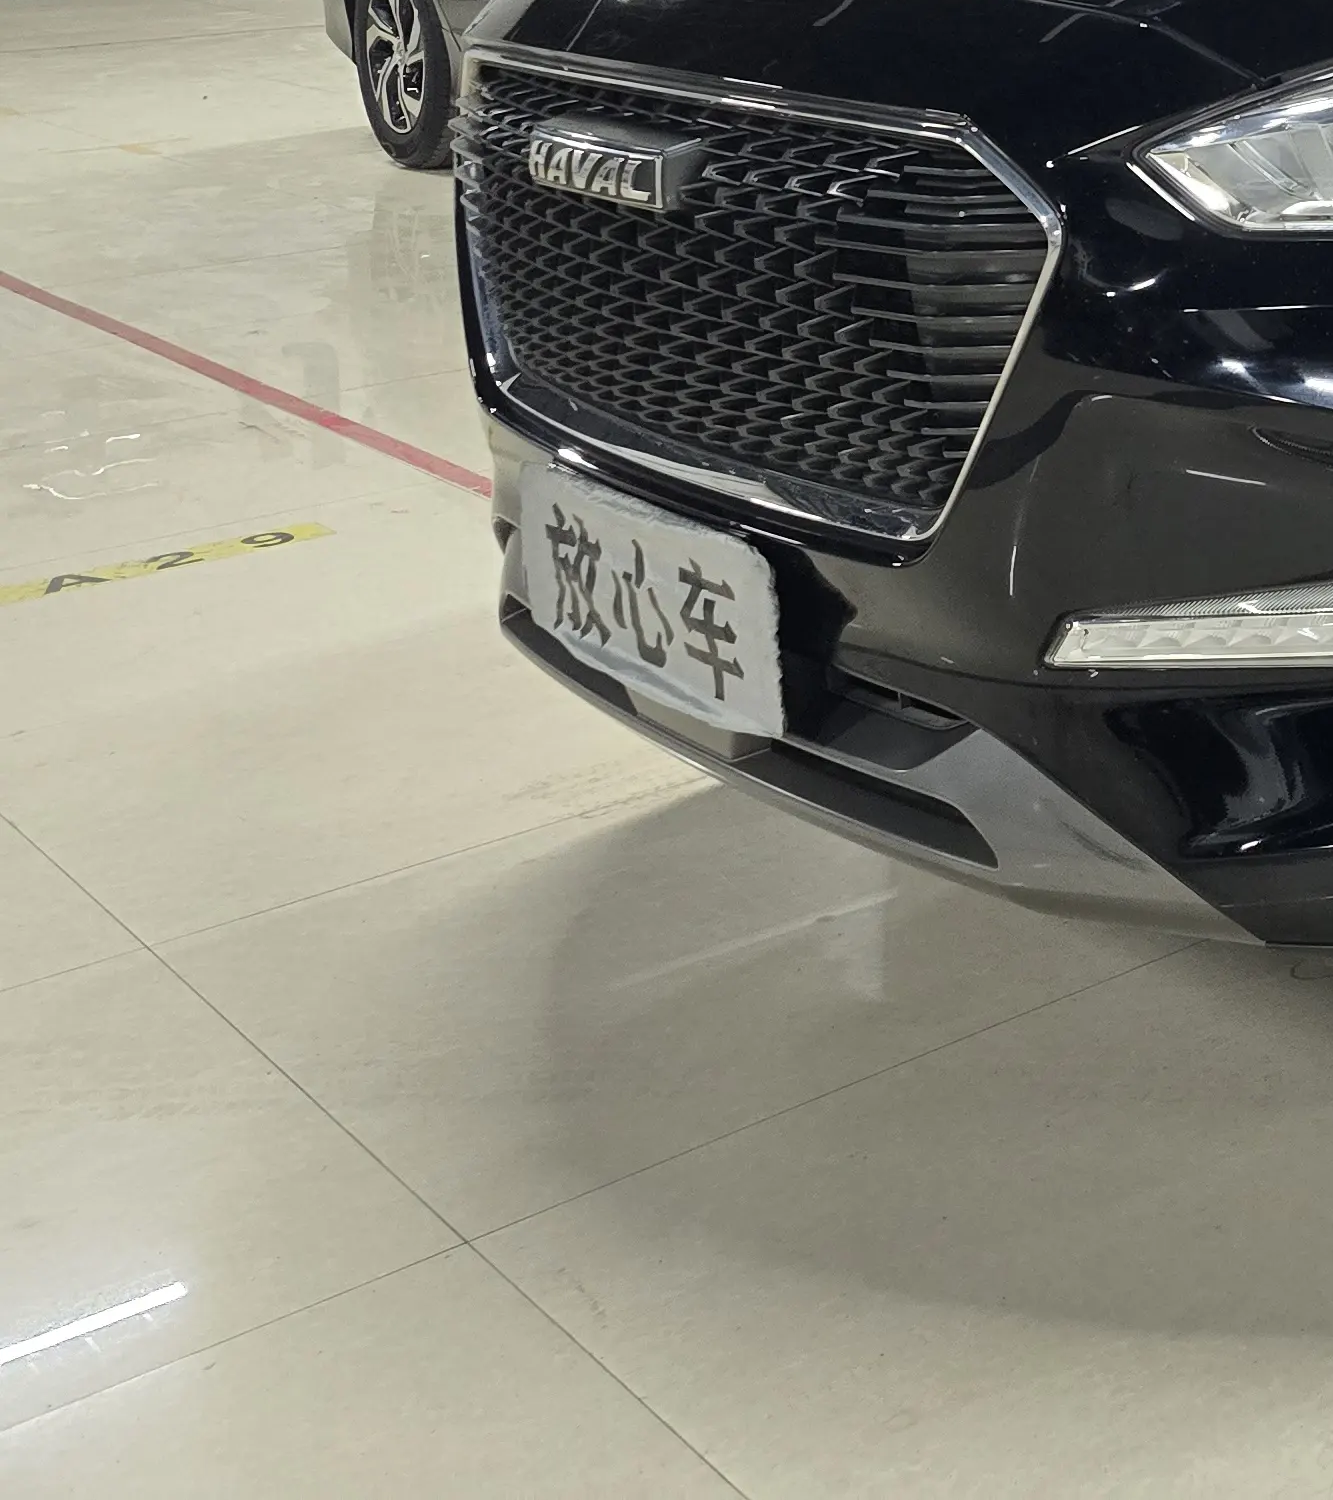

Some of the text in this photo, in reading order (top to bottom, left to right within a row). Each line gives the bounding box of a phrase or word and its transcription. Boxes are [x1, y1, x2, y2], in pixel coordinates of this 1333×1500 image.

[528, 140, 652, 202] HAVAL
[544, 503, 745, 702] 放心车
